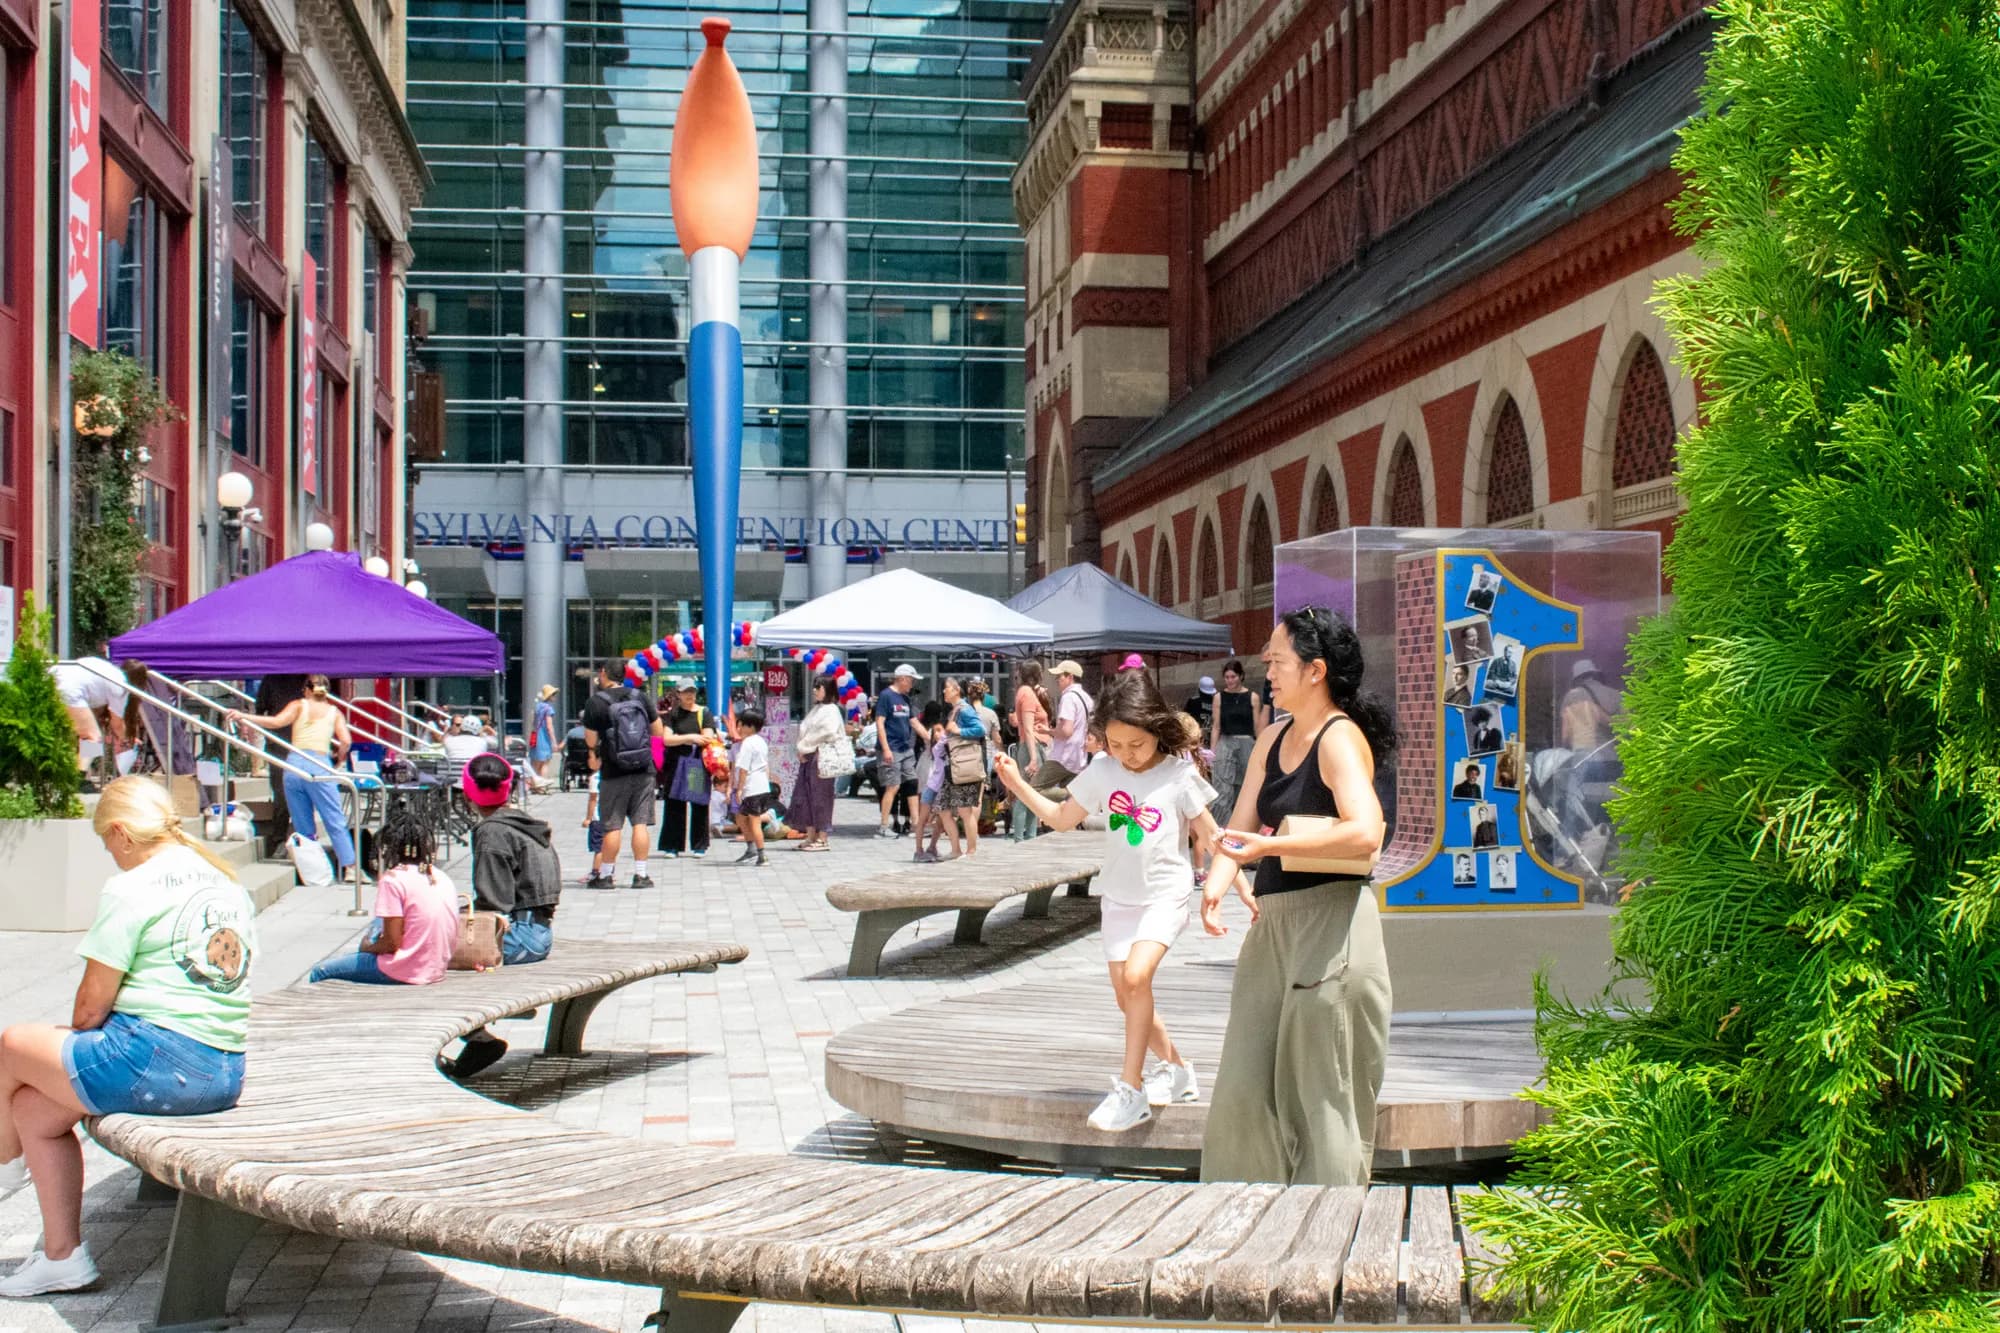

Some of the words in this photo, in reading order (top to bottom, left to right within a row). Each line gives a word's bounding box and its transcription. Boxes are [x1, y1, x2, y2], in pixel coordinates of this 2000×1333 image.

[69, 46, 91, 313] PAFA
[614, 514, 890, 548] CONENTION
[902, 518, 1016, 551] CENT
[767, 670, 789, 680] PAFA
